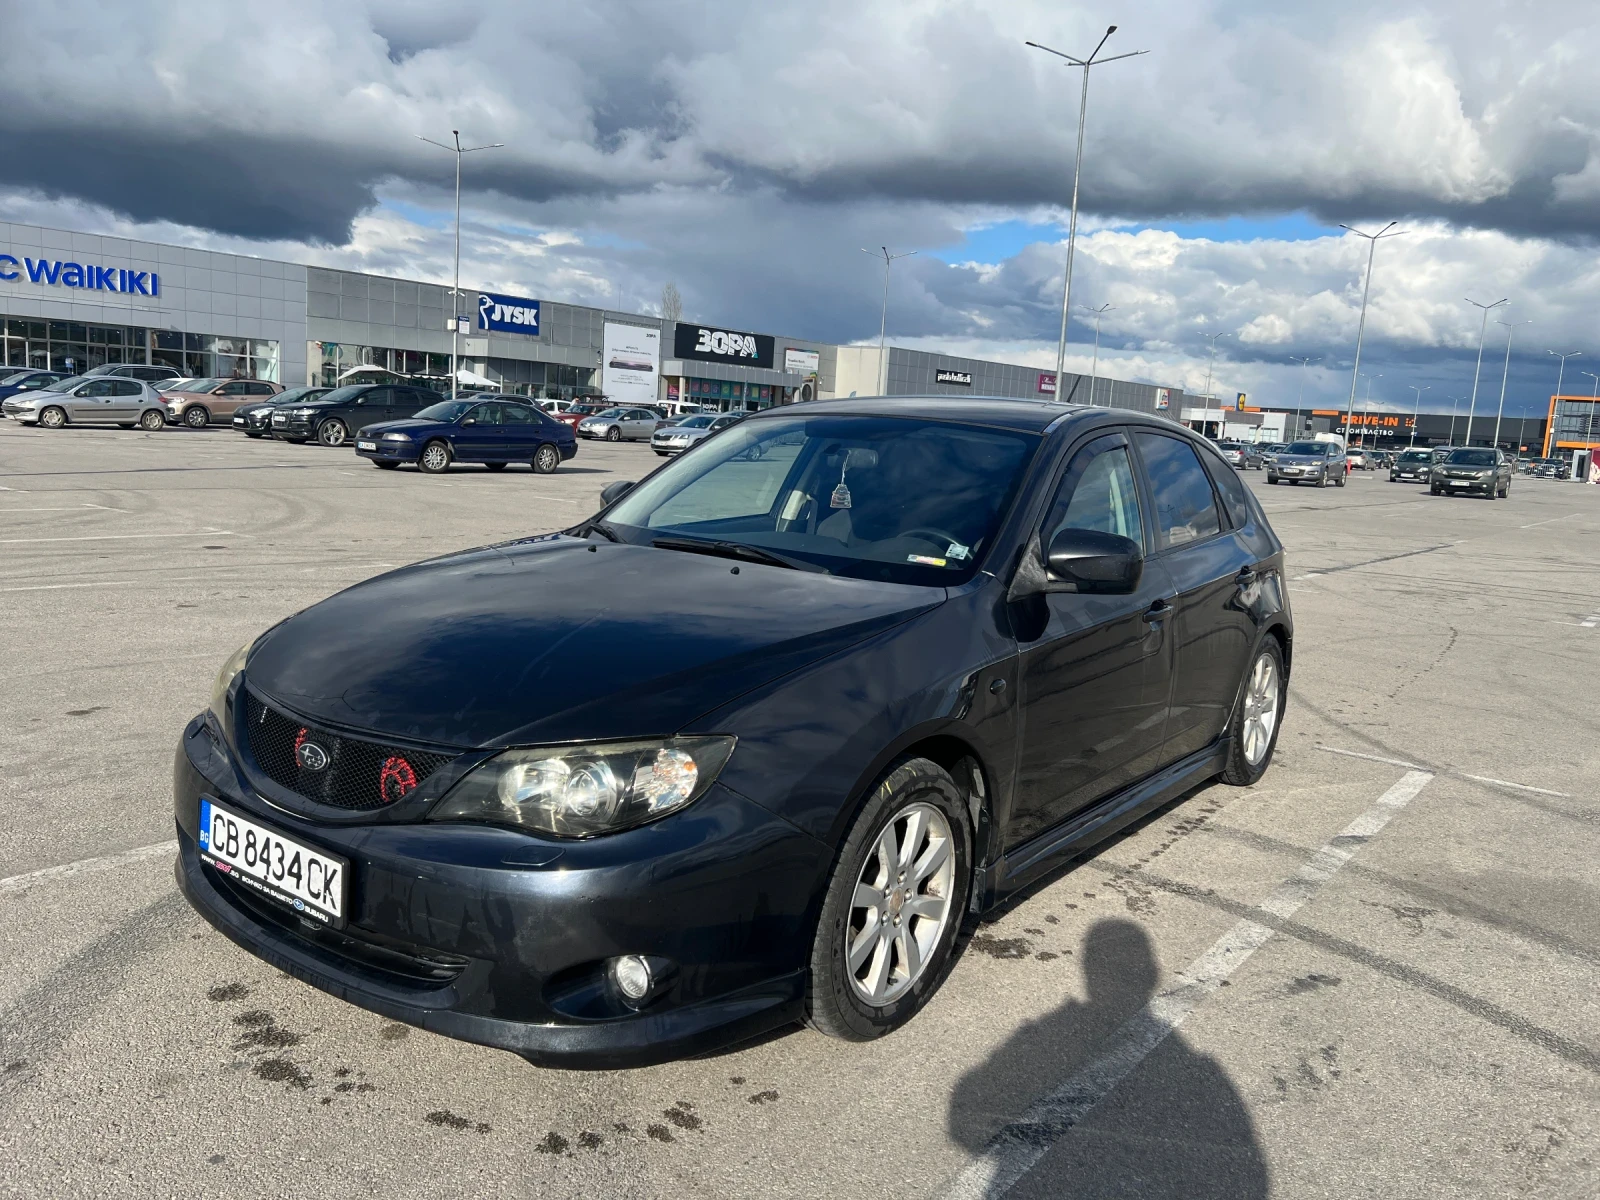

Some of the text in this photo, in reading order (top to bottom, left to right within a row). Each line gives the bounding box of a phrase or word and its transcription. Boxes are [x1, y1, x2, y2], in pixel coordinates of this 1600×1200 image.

[491, 303, 538, 326] JYSK
[695, 328, 759, 358] ЗОРА
[1341, 414, 1399, 427] DRIVE-IN
[1336, 427, 1394, 436] СТОИТЕЛСТВО
[200, 829, 209, 844] BG
[304, 905, 329, 923] SUBARU
